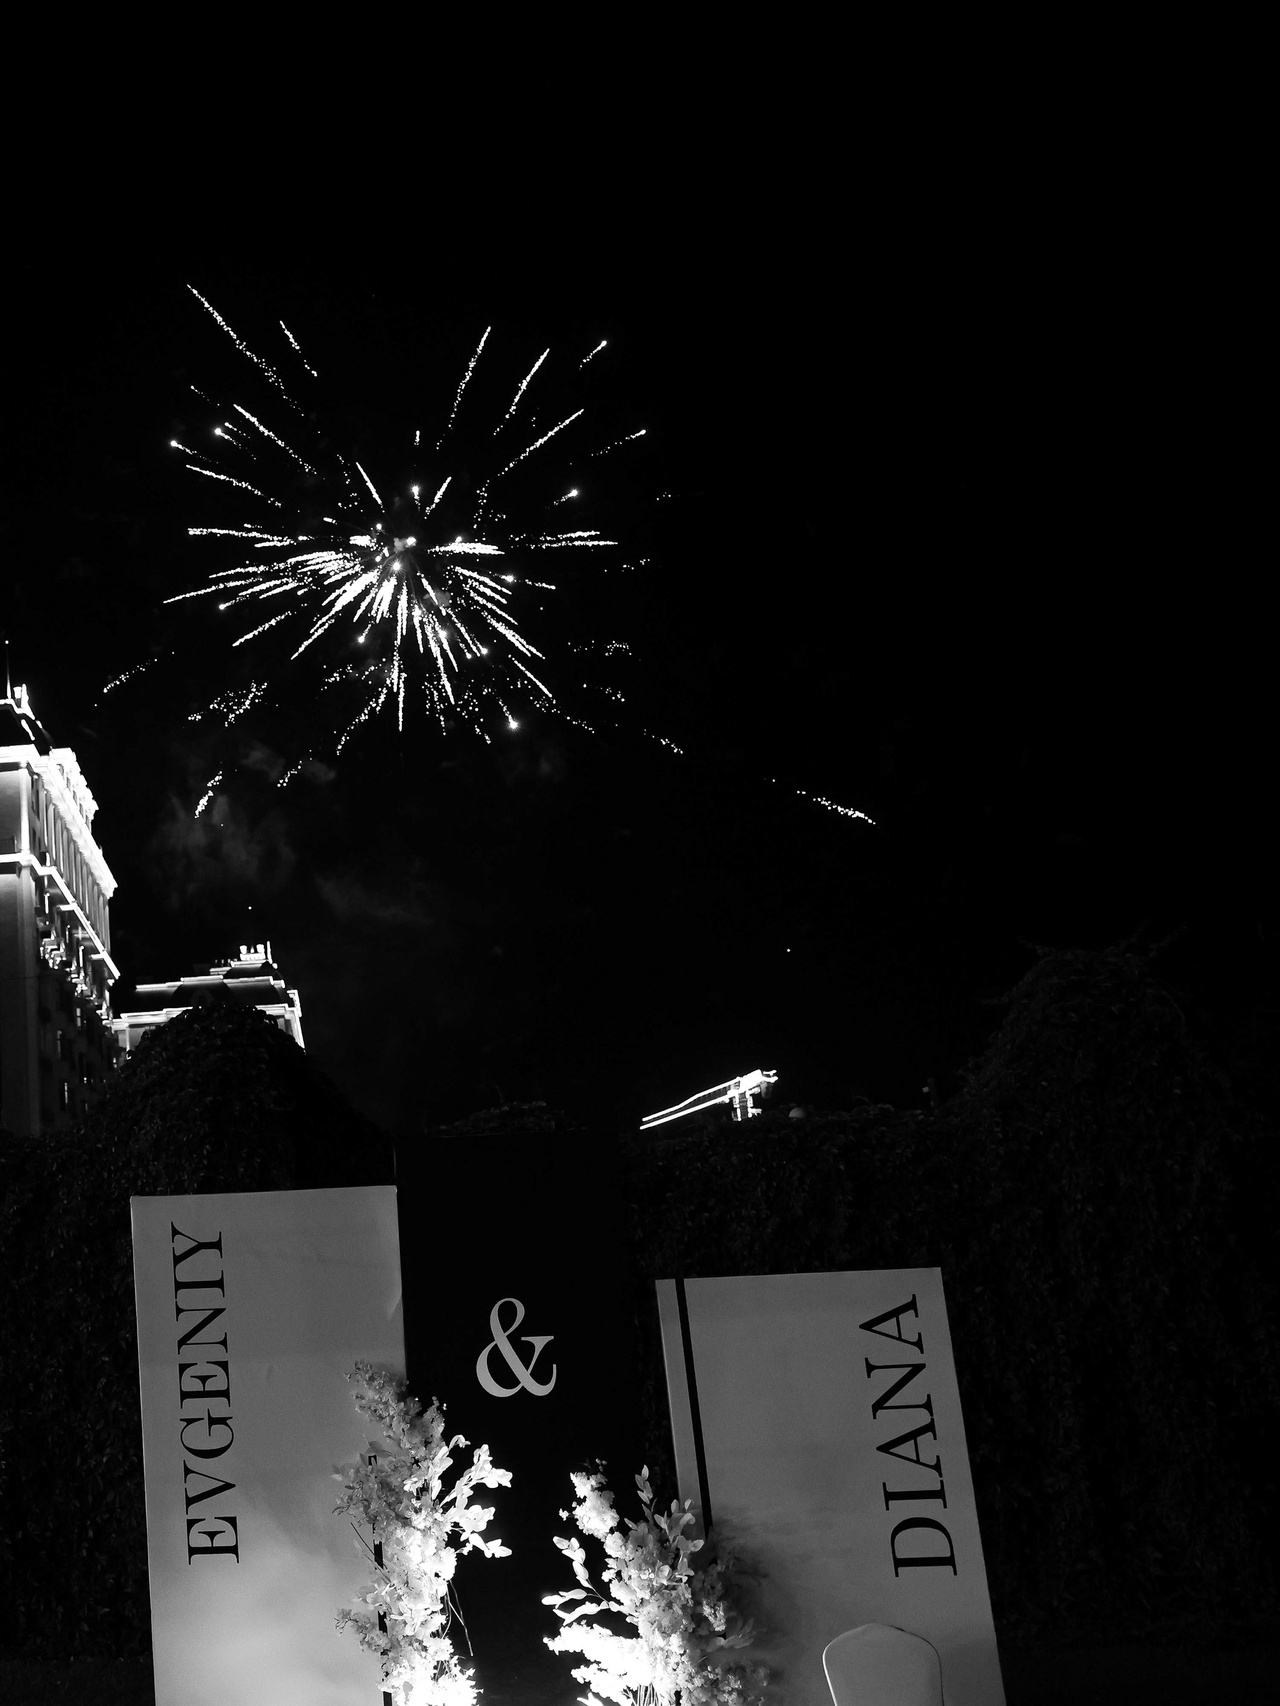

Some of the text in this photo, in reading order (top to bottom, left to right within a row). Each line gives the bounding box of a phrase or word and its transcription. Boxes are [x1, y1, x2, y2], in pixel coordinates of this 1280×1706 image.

[170, 1221, 240, 1565] EVGENIY
[476, 1297, 558, 1397] &
[858, 1293, 958, 1577] DIANA
